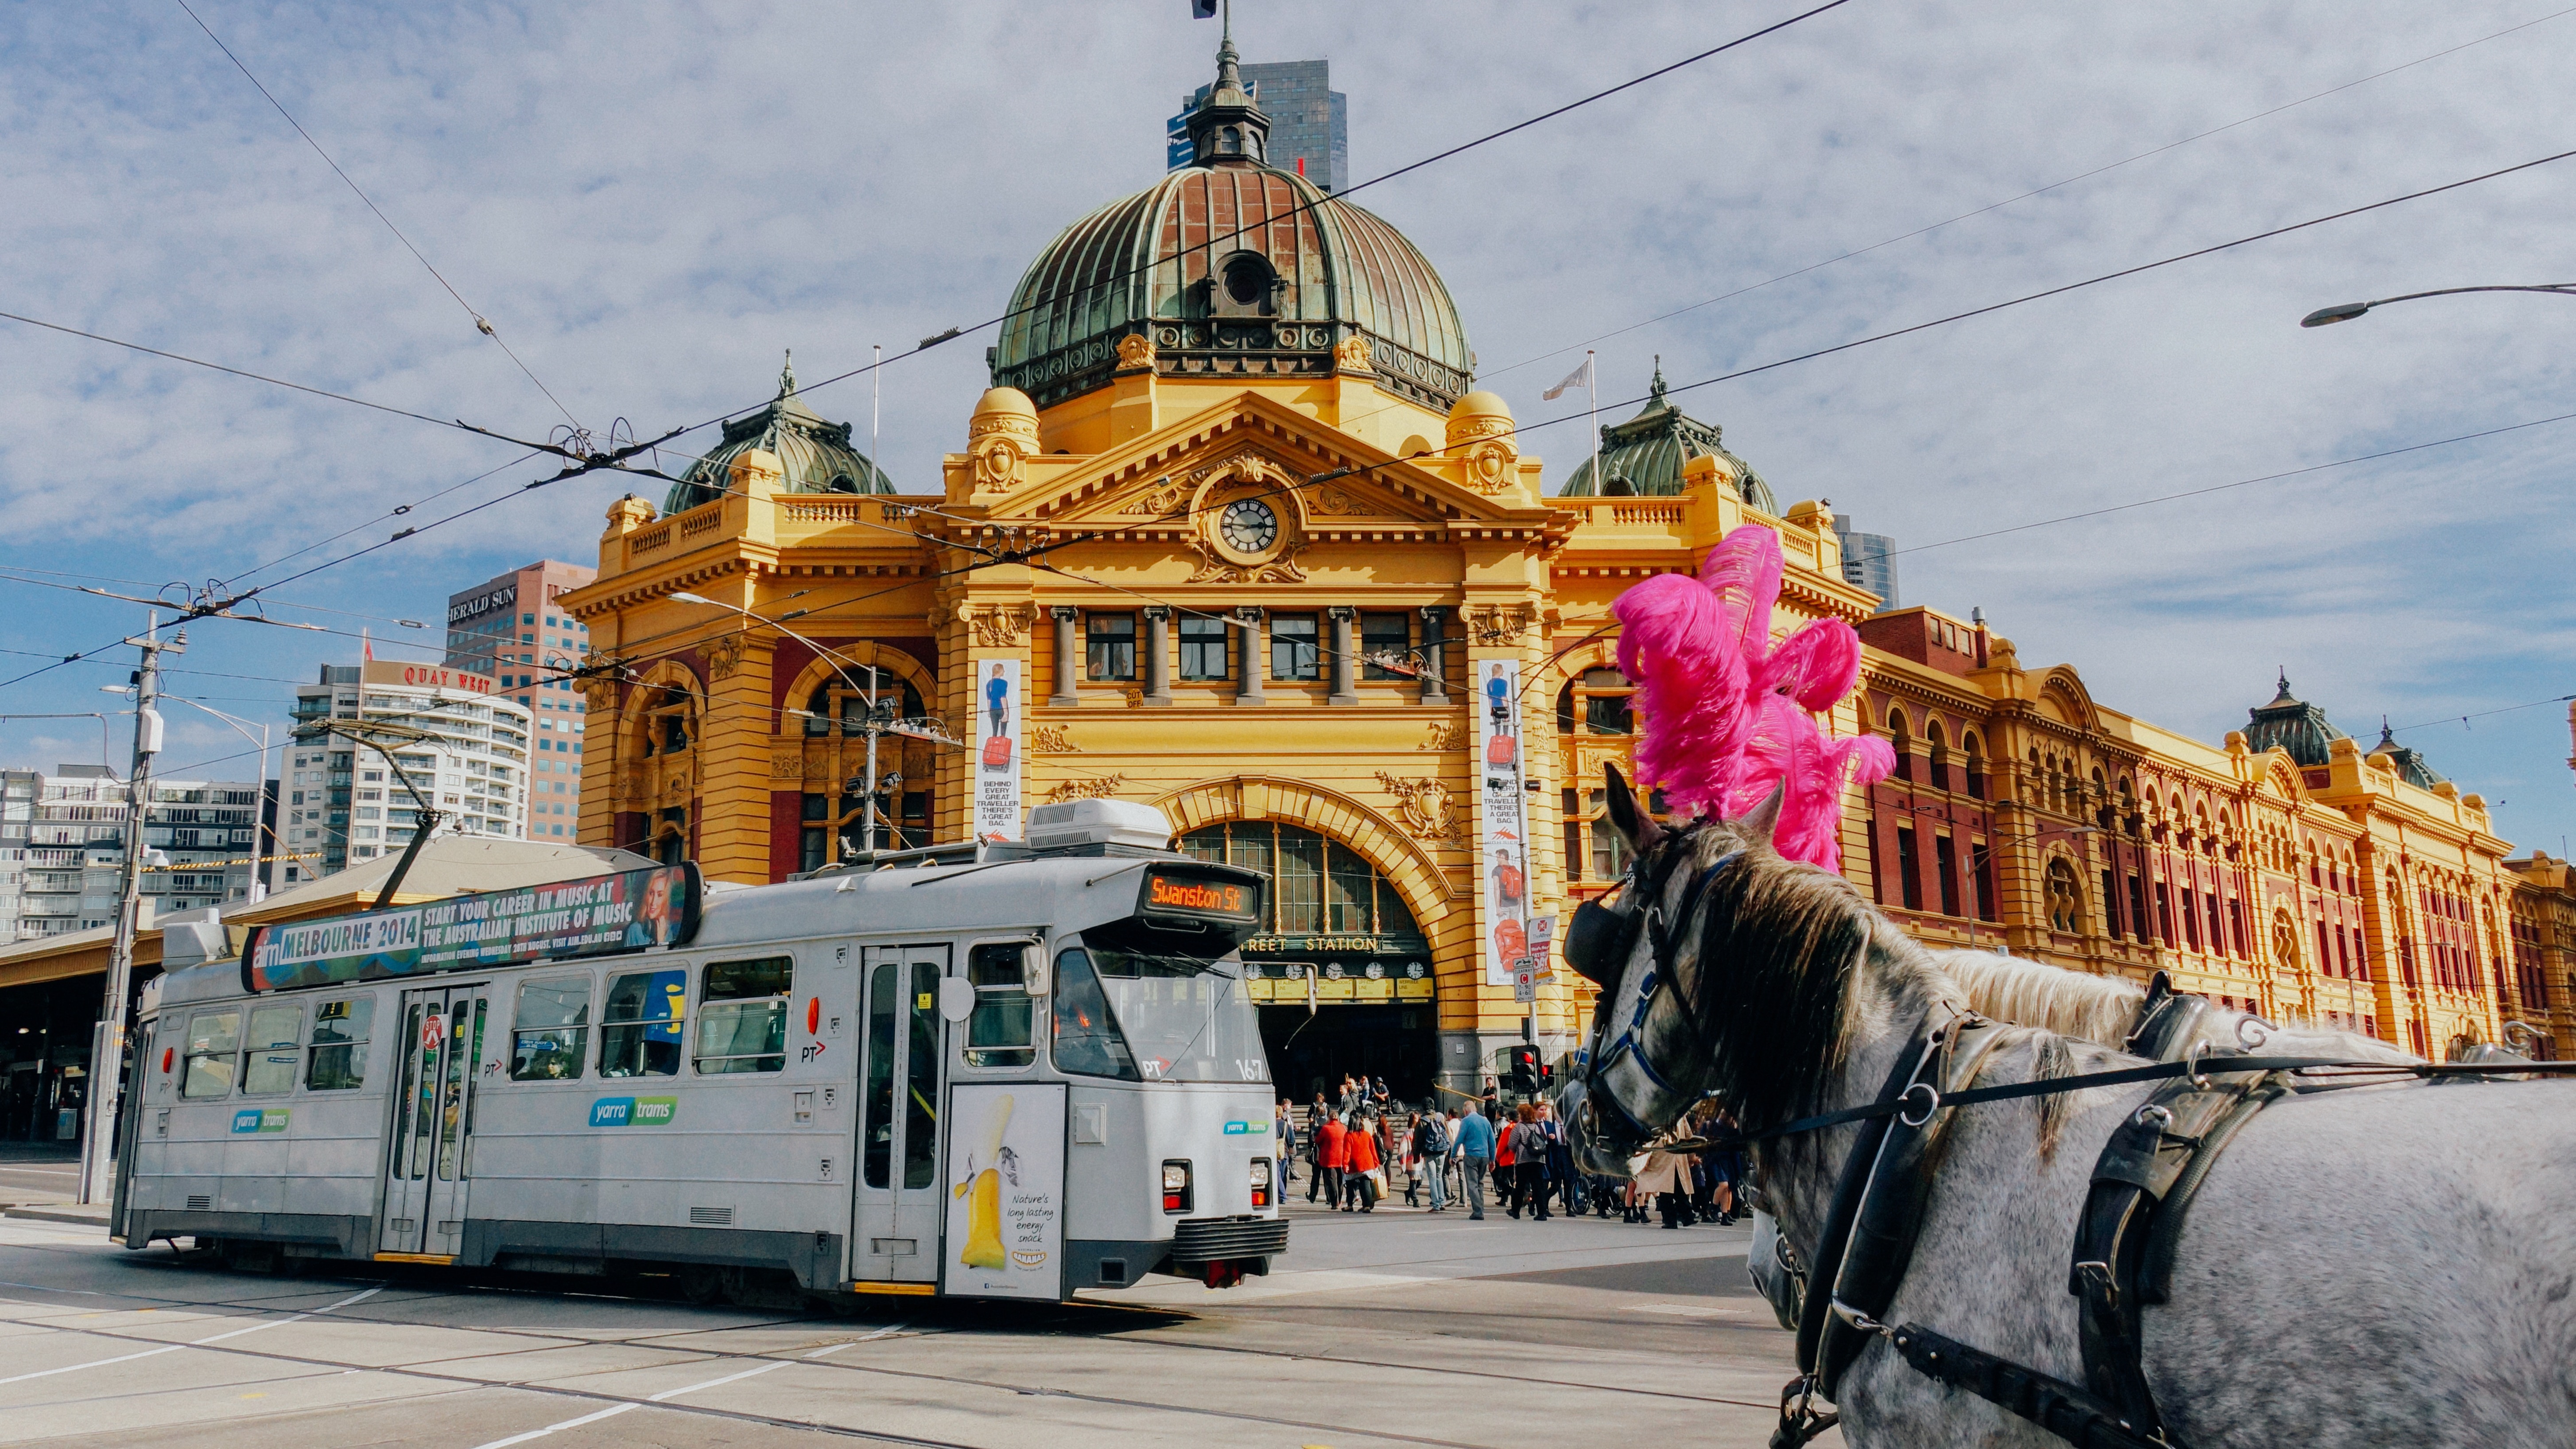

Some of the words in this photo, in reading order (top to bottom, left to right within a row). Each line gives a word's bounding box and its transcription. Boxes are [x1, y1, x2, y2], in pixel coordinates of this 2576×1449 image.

[448, 597, 489, 622] HERALD
[492, 587, 517, 607] SUN
[404, 667, 449, 685] QUAY
[458, 674, 490, 694] WEST
[1152, 878, 1221, 909] Swanston
[1224, 887, 1240, 911] St
[424, 905, 457, 926] START
[460, 901, 489, 921] YOUR
[493, 894, 535, 917] CAREER
[538, 891, 552, 911] IN
[555, 884, 594, 909] MUSIC
[597, 882, 614, 902] AT
[423, 928, 442, 948] THE
[444, 918, 512, 945] AUSTRALIAN
[515, 910, 570, 936] INSTITUTE
[574, 908, 590, 928] OF
[593, 901, 633, 926] MUSIC
[282, 922, 372, 960] MELBOURNE
[377, 916, 418, 947] 2014
[1241, 938, 1287, 952] REET
[1307, 938, 1377, 951] STATION
[253, 940, 280, 969] aim
[421, 951, 456, 963] INFORMATION
[457, 949, 479, 960] EVENING
[480, 944, 512, 956] WEDNESDAY
[513, 942, 527, 953] 28TH
[528, 940, 551, 951] AUGUST.
[553, 937, 566, 948] VISIT
[567, 933, 602, 946] AIM.EDU.AU
[1534, 956, 1548, 969] DAY
[1521, 974, 1527, 983] C
[426, 1020, 440, 1031] STOP
[802, 1046, 817, 1063] PT
[485, 1064, 496, 1077] PT
[1142, 1061, 1161, 1077] PT
[1235, 1059, 1262, 1080] 167
[596, 1104, 626, 1123] yarra
[636, 1102, 670, 1118] trams
[236, 1115, 257, 1130] yarra
[264, 1113, 287, 1127] trams
[1227, 1123, 1244, 1133] yarra
[1012, 1193, 1049, 1204] Nature's
[1007, 1208, 1024, 1221] long
[1026, 1207, 1054, 1221] lasting
[1016, 1222, 1044, 1234] energy
[1018, 1233, 1043, 1243] snack
[1013, 1252, 1045, 1264] BANANAS
